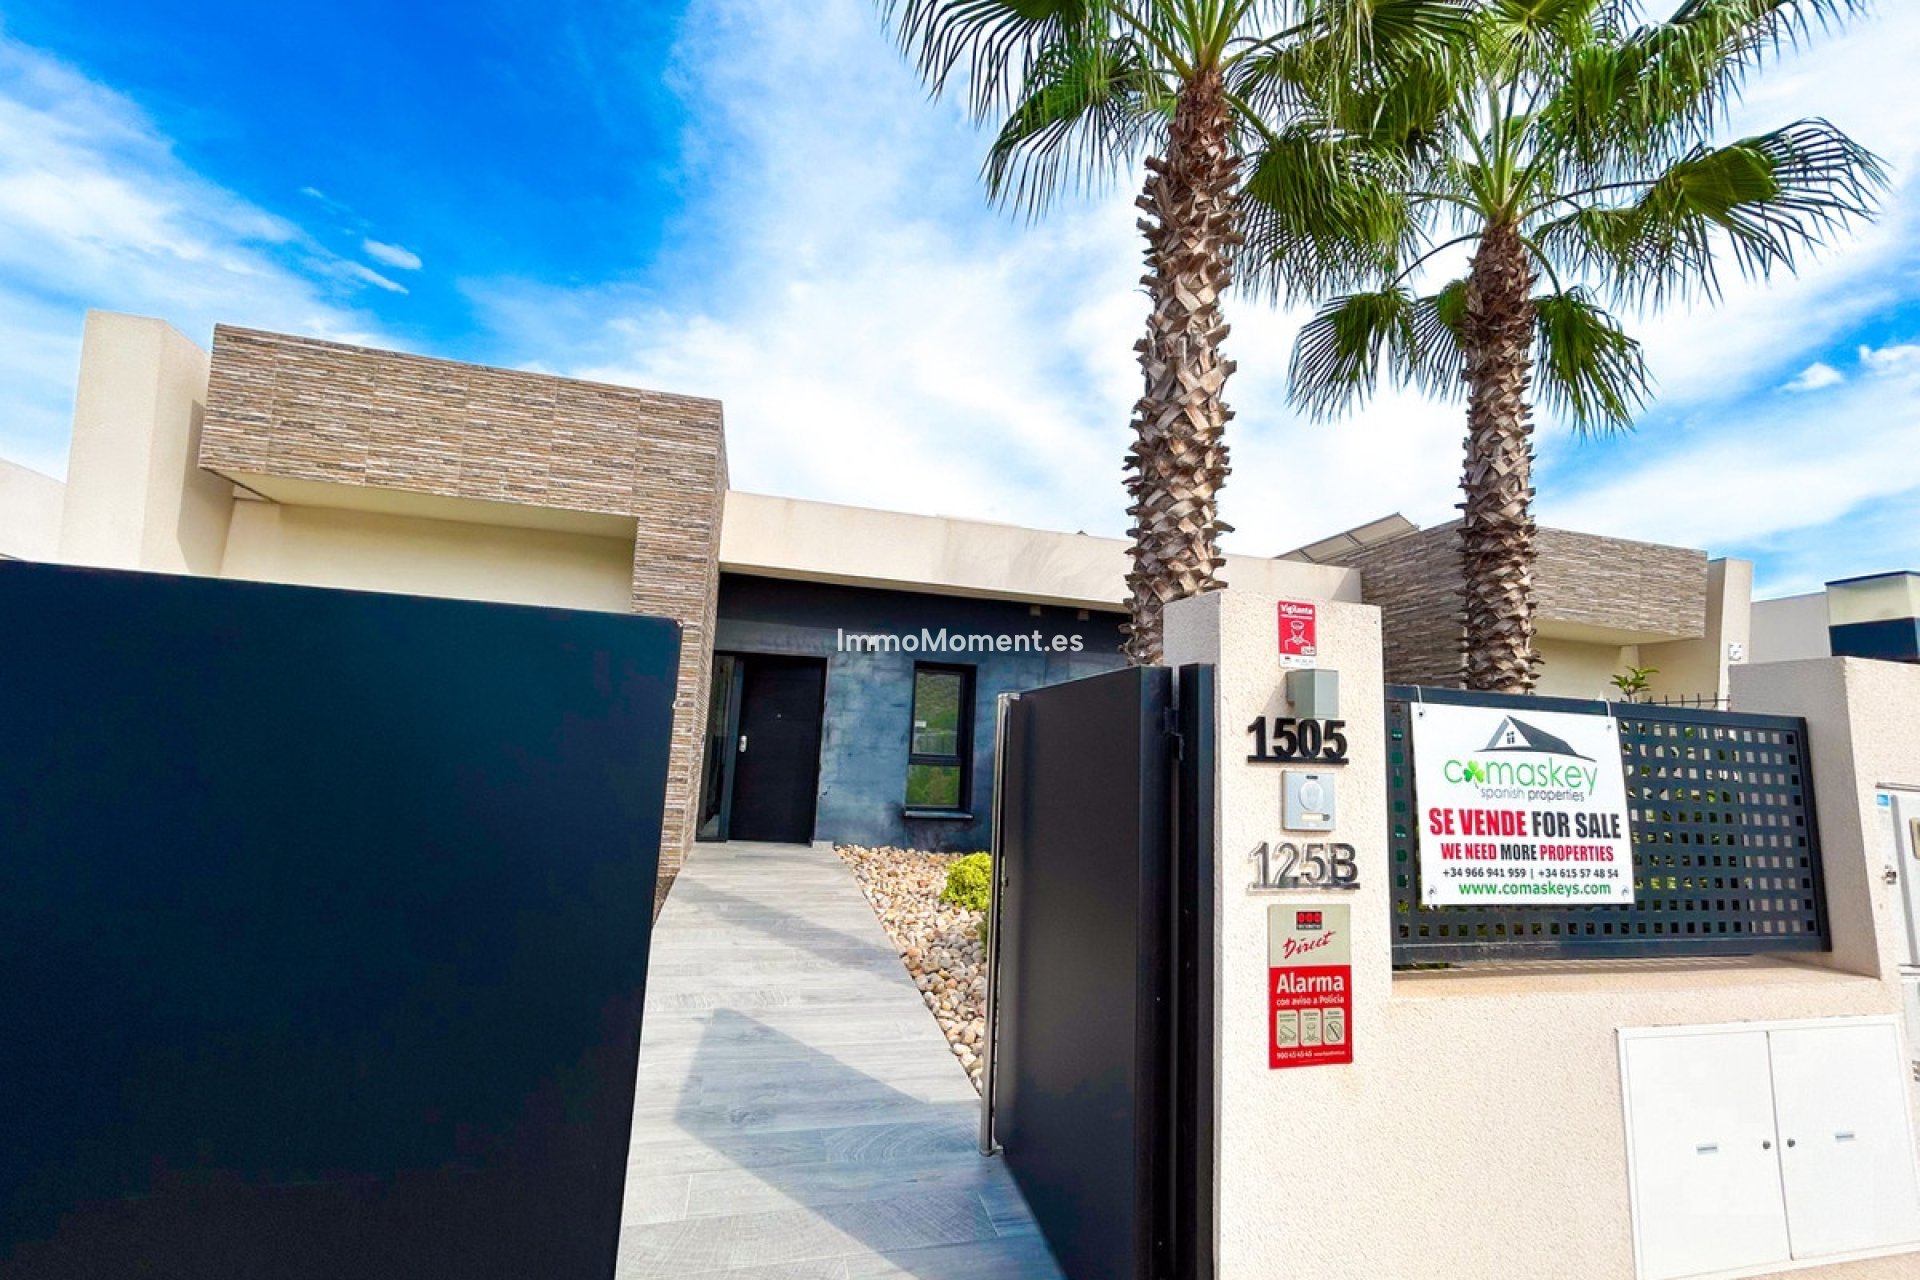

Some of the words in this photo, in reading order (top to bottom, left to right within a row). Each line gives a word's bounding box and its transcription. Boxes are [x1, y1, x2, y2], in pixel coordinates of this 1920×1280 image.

[1248, 716, 1348, 760] 1505
[1480, 786, 1526, 801] spanish
[1527, 788, 1585, 803] properties
[1428, 807, 1456, 837] SE
[1458, 809, 1528, 838] VENDE
[1531, 810, 1571, 839] FOR
[1574, 811, 1622, 840] SALE
[1248, 841, 1359, 888] 125B
[1440, 842, 1462, 861] WE
[1464, 843, 1498, 861] NEED
[1499, 844, 1538, 862] MORE
[1539, 844, 1615, 863] PROPERTIES
[1442, 867, 1463, 878] +34
[1465, 867, 1485, 878] 966
[1486, 867, 1506, 878] 941
[1508, 868, 1527, 878] 959
[1538, 868, 1558, 879] +34
[1559, 868, 1578, 879] 615
[1579, 868, 1592, 879] 57
[1592, 868, 1607, 879] 48
[1607, 868, 1619, 879] 54
[1458, 881, 1613, 897] www.comaskeys.com
[1282, 930, 1336, 960] Direct
[1276, 971, 1345, 995] Alarma
